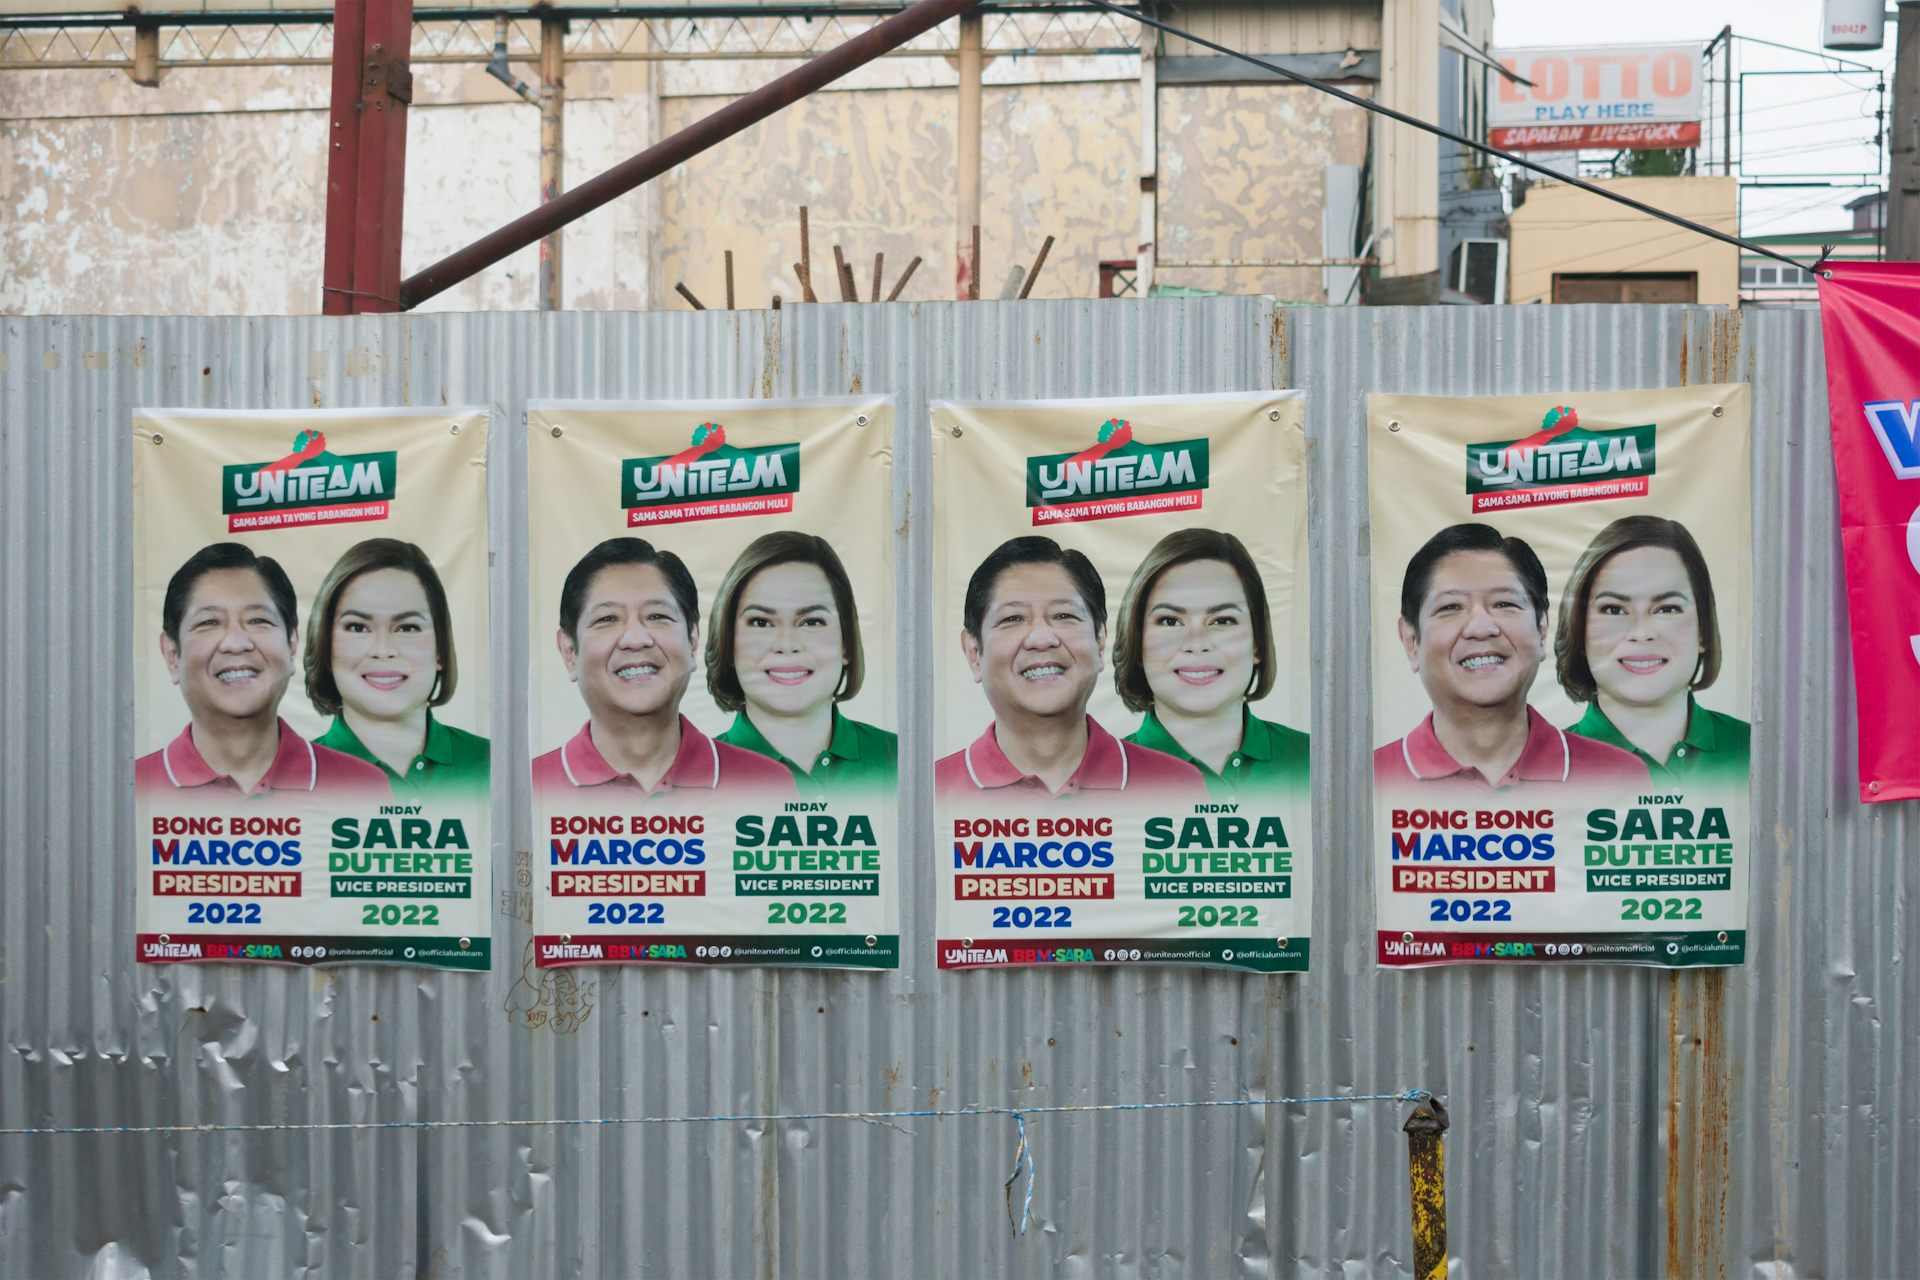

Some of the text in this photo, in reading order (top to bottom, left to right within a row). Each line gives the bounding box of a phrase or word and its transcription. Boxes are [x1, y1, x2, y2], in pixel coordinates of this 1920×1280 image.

[1498, 51, 1692, 104] LOTTO
[1536, 104, 1654, 120] PLAY HERE
[1590, 123, 1681, 142] LIVESTOCK
[1479, 436, 1642, 485] UNITEAM
[234, 461, 384, 506] UNITEAM
[634, 454, 787, 500] UNITEAM
[1039, 450, 1196, 499] UNITEAM
[1532, 490, 1569, 502] TAYONG
[1570, 485, 1619, 498] BABANGON
[1621, 482, 1643, 492] MULI
[283, 512, 316, 522] TAYONG
[318, 508, 362, 520] BABANGON
[364, 506, 384, 516] MULI
[684, 506, 718, 517] TAYONG
[719, 501, 766, 514] BABANGON
[767, 498, 788, 509] MULI
[1090, 502, 1126, 515] TAYONG
[1127, 498, 1174, 511] BABANGON
[1176, 495, 1197, 506] MULI
[784, 803, 828, 812] INDAY
[1194, 804, 1239, 814] INDAY
[1638, 795, 1684, 804] INDAY
[380, 806, 422, 815] INDAY
[1392, 809, 1554, 830] BONG BONG
[152, 817, 301, 836] BONG BONG
[331, 818, 469, 850] SARA
[551, 816, 704, 834] BONG BONG
[736, 815, 877, 846] SARA
[954, 818, 1112, 838] BONG BONG
[1144, 816, 1288, 849] SARA
[1586, 808, 1730, 841] SARA
[152, 838, 302, 866] MARCOS
[551, 838, 706, 866] MARCOS
[954, 841, 1114, 869] MARCOS
[1392, 832, 1555, 861] MARCOS
[1584, 844, 1733, 866] DUTERTE
[329, 852, 473, 874] DUTERTE
[733, 850, 880, 871] DUTERTE
[1142, 852, 1292, 874] DUTERTE
[160, 874, 296, 894] PRESIDENT
[336, 881, 466, 893] VICE PRESIDENT
[558, 874, 700, 893] PRESIDENT
[740, 879, 874, 891] VICE PRESIDENT
[962, 877, 1108, 897] PRESIDENT
[1150, 882, 1286, 894] VICE PRESIDENT
[1400, 870, 1549, 889] PRESIDENT
[1592, 873, 1726, 886] VICE PRESIDENT
[188, 902, 262, 924] 2022
[362, 904, 439, 925] 2022
[588, 902, 664, 924] 2022
[768, 902, 846, 924] 2022
[992, 906, 1072, 928] 2022
[1178, 906, 1258, 927] 2022
[1430, 900, 1512, 921] 2022
[1621, 898, 1702, 920] 2022
[144, 944, 202, 958] UNITEAM
[542, 945, 604, 958] UNITEAM
[826, 948, 892, 956] @officialuniteam
[945, 949, 1008, 963] UNITEAM
[1384, 941, 1446, 956] UNITEAM
[1681, 944, 1739, 953] @officialuniteam
